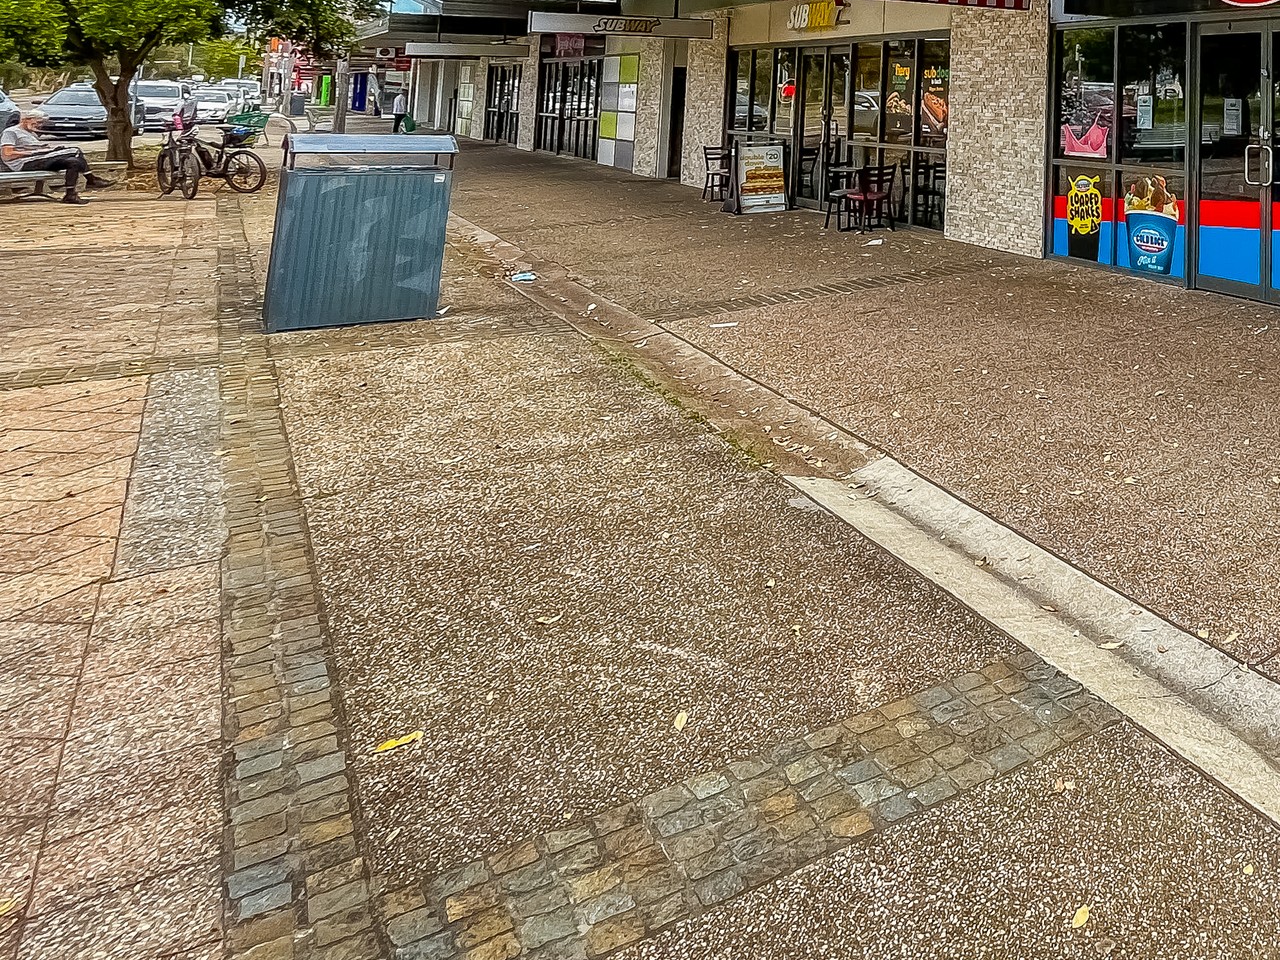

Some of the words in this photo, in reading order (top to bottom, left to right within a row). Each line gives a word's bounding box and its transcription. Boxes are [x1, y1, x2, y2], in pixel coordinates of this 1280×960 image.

[786, 0, 837, 30] SUBWAY
[593, 18, 661, 32] SUBWAY
[1070, 192, 1099, 207] LOADED
[1069, 204, 1100, 222] SHAKES
